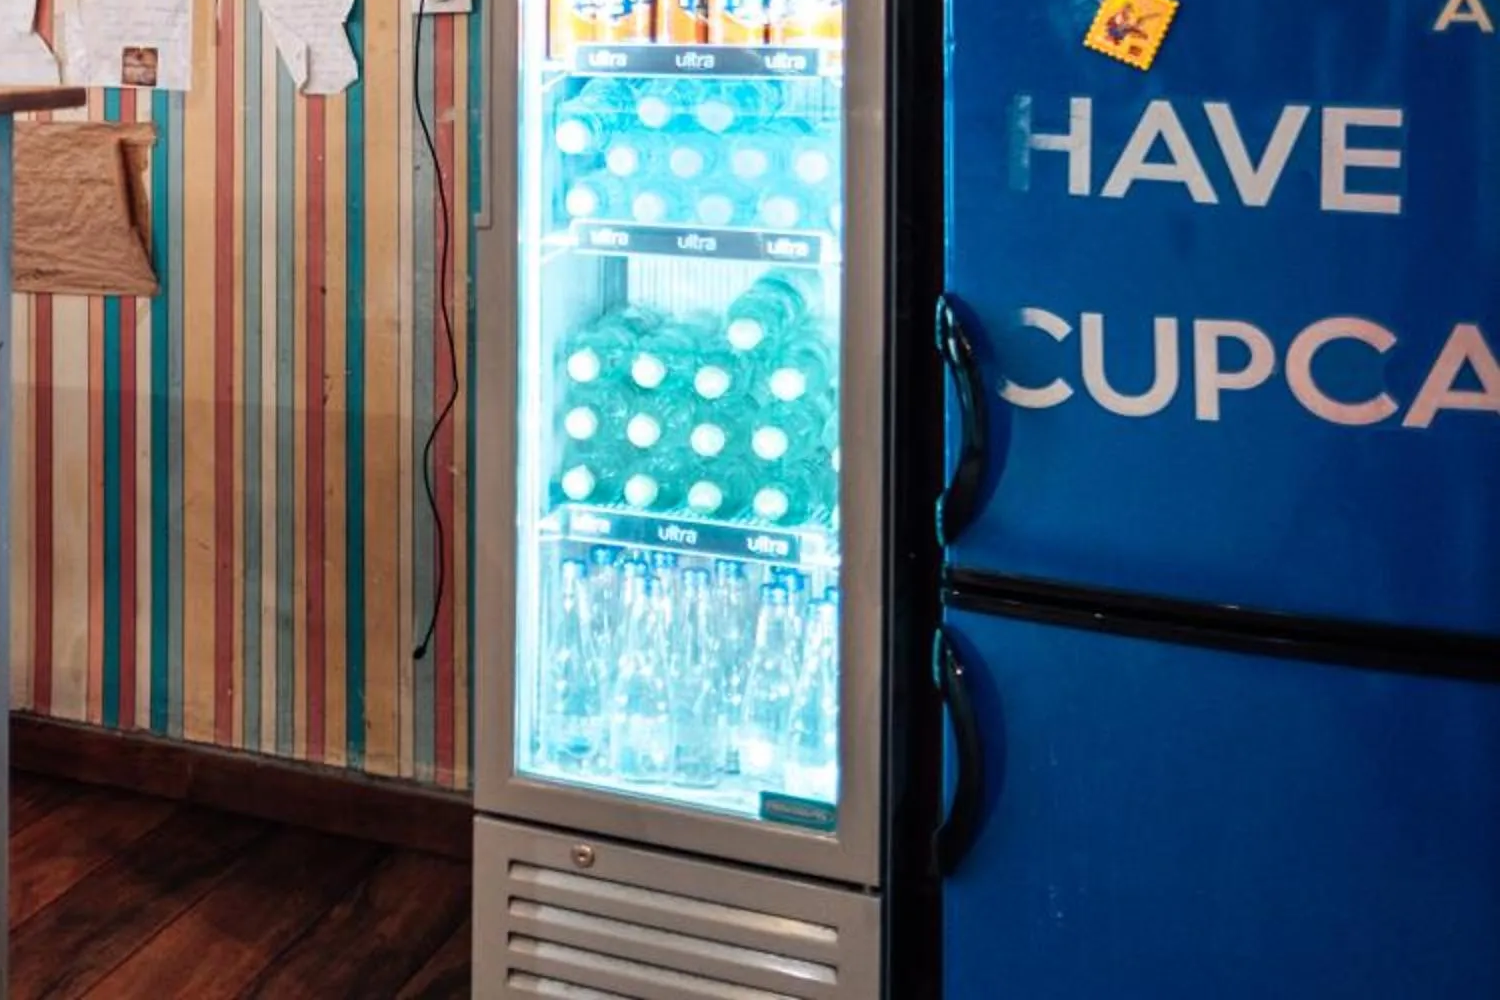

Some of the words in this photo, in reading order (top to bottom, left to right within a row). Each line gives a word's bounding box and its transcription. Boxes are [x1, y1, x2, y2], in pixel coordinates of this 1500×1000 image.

[675, 51, 715, 68] ultra
[765, 52, 807, 70] ultra
[1008, 94, 1404, 215] HAVE
[677, 233, 717, 251] ultra
[766, 238, 809, 257] ultra
[998, 306, 1500, 428] CUPCA
[658, 525, 698, 545] ultra
[746, 536, 789, 557] ultra
